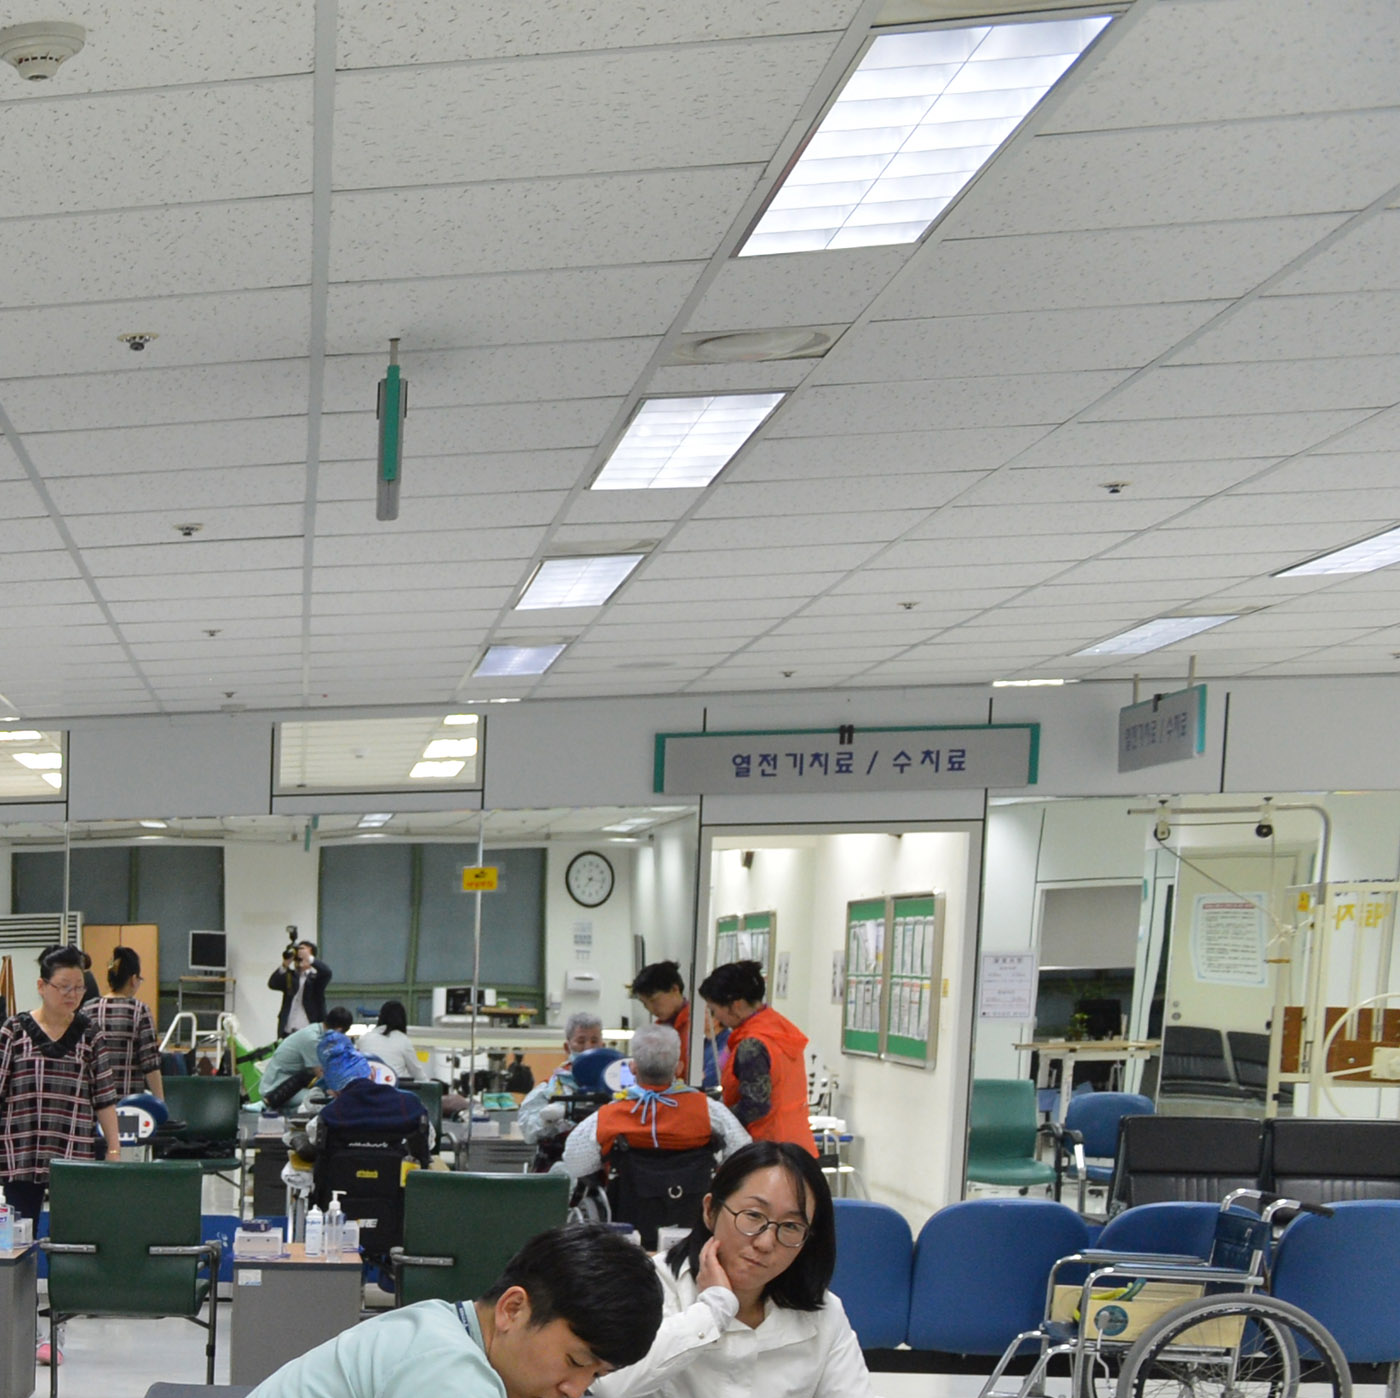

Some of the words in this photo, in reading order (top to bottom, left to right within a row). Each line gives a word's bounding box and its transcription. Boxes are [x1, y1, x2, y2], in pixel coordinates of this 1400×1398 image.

[732, 751, 854, 778] 열전기치료
[866, 750, 879, 775] /
[892, 749, 967, 774] 수치료
